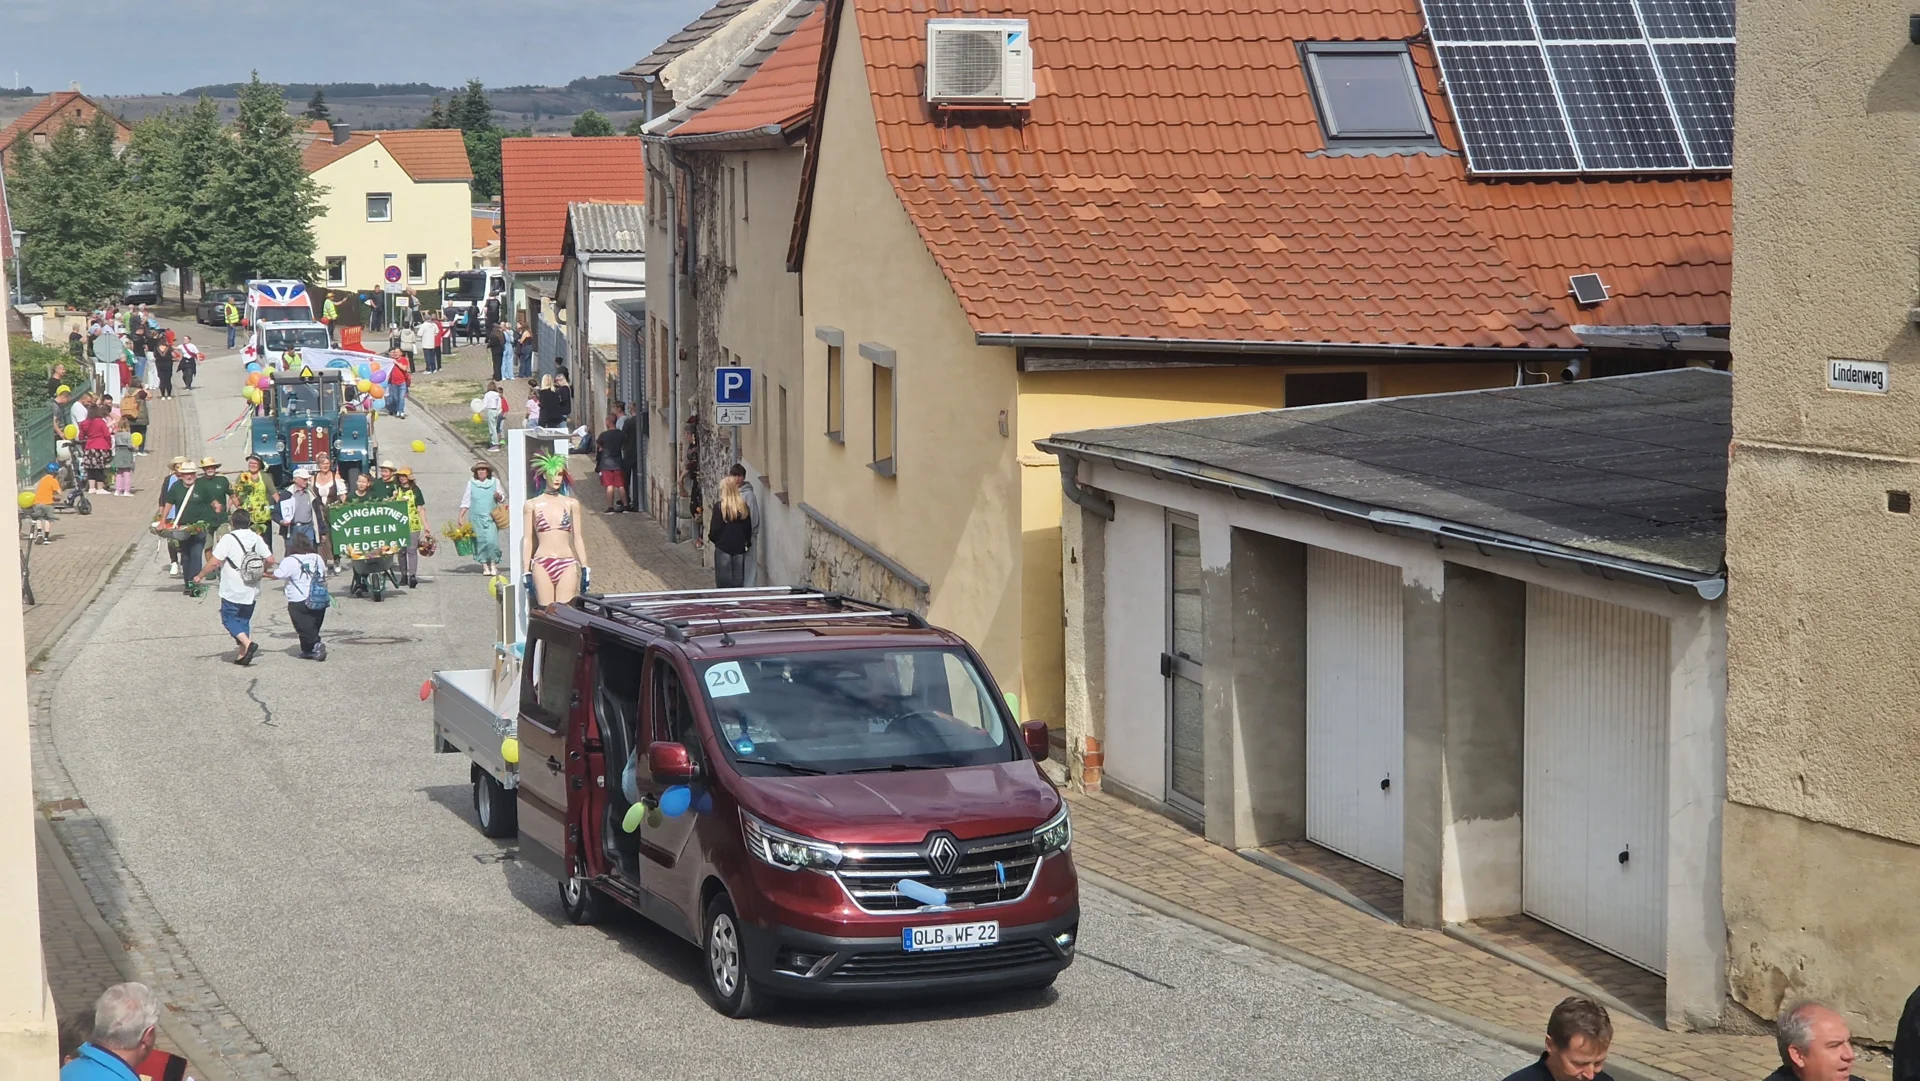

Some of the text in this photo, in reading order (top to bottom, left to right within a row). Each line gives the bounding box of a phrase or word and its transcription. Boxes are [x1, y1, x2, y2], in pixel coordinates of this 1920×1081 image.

[724, 372, 743, 399] P
[1833, 363, 1883, 390] Lindenweg
[285, 506, 294, 518] 21
[344, 523, 397, 537] VEREIN
[390, 538, 407, 548] eV.
[708, 669, 740, 687] 20
[914, 928, 944, 946] QLB
[955, 926, 974, 942] WF
[978, 924, 996, 940] 22
